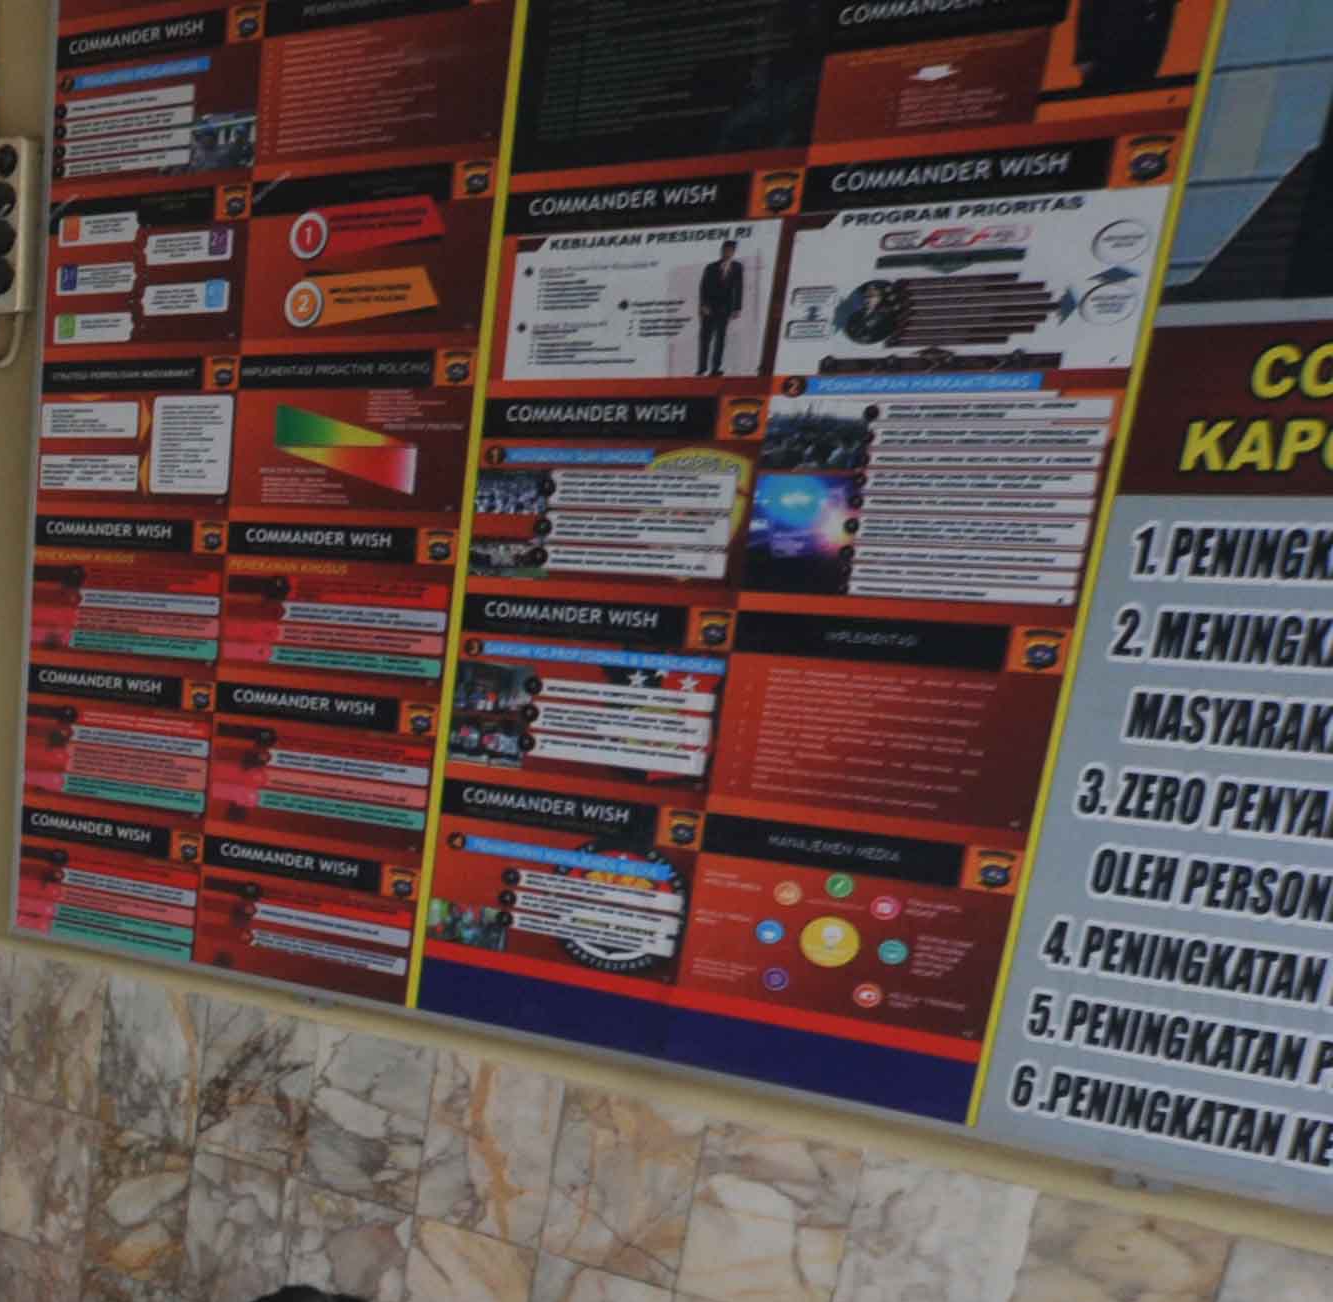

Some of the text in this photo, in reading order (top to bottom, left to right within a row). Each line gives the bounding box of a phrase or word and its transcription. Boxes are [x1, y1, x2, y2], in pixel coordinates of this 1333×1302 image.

[839, 0, 981, 24] COMMAND
[68, 19, 205, 55] COMMANDER WISH
[831, 151, 1073, 193] COMMANDER WISH
[528, 184, 718, 217] COMMANDER WISH
[840, 195, 1086, 227] PROGRAM PRIORITAS
[549, 226, 753, 251] KEBIJAKAN PRESIDEN RI
[505, 404, 688, 423] COMMANDER WISH
[1178, 418, 1333, 472] KAP
[45, 520, 173, 540] COMMANDER WISH
[245, 528, 393, 548] COMMANDER WISH
[1134, 526, 1333, 581] 1. PENINGK
[484, 600, 659, 629] COMMANDER WISH
[1111, 608, 1333, 668] 2. MENINGK
[38, 669, 163, 694] COMMANDER WISH
[232, 688, 376, 716] COMMANDER WISH
[1124, 691, 1333, 755] MASYARAK
[462, 786, 631, 824] COMMANDER WISH
[1078, 767, 1333, 839] 3. ZERO PENYA
[30, 812, 152, 843] COMMANDER WISH
[220, 842, 360, 878] COMMANDER WISH
[767, 833, 902, 863] MANAJEMEN MEDIA
[1091, 848, 1180, 901] OLEH
[1042, 920, 1071, 966] 4.
[1078, 925, 1328, 1003] PENINGKATAN
[1027, 993, 1056, 1039] 5.
[1064, 999, 1307, 1081] PENINGKATAN
[1011, 1064, 1036, 1109] 6
